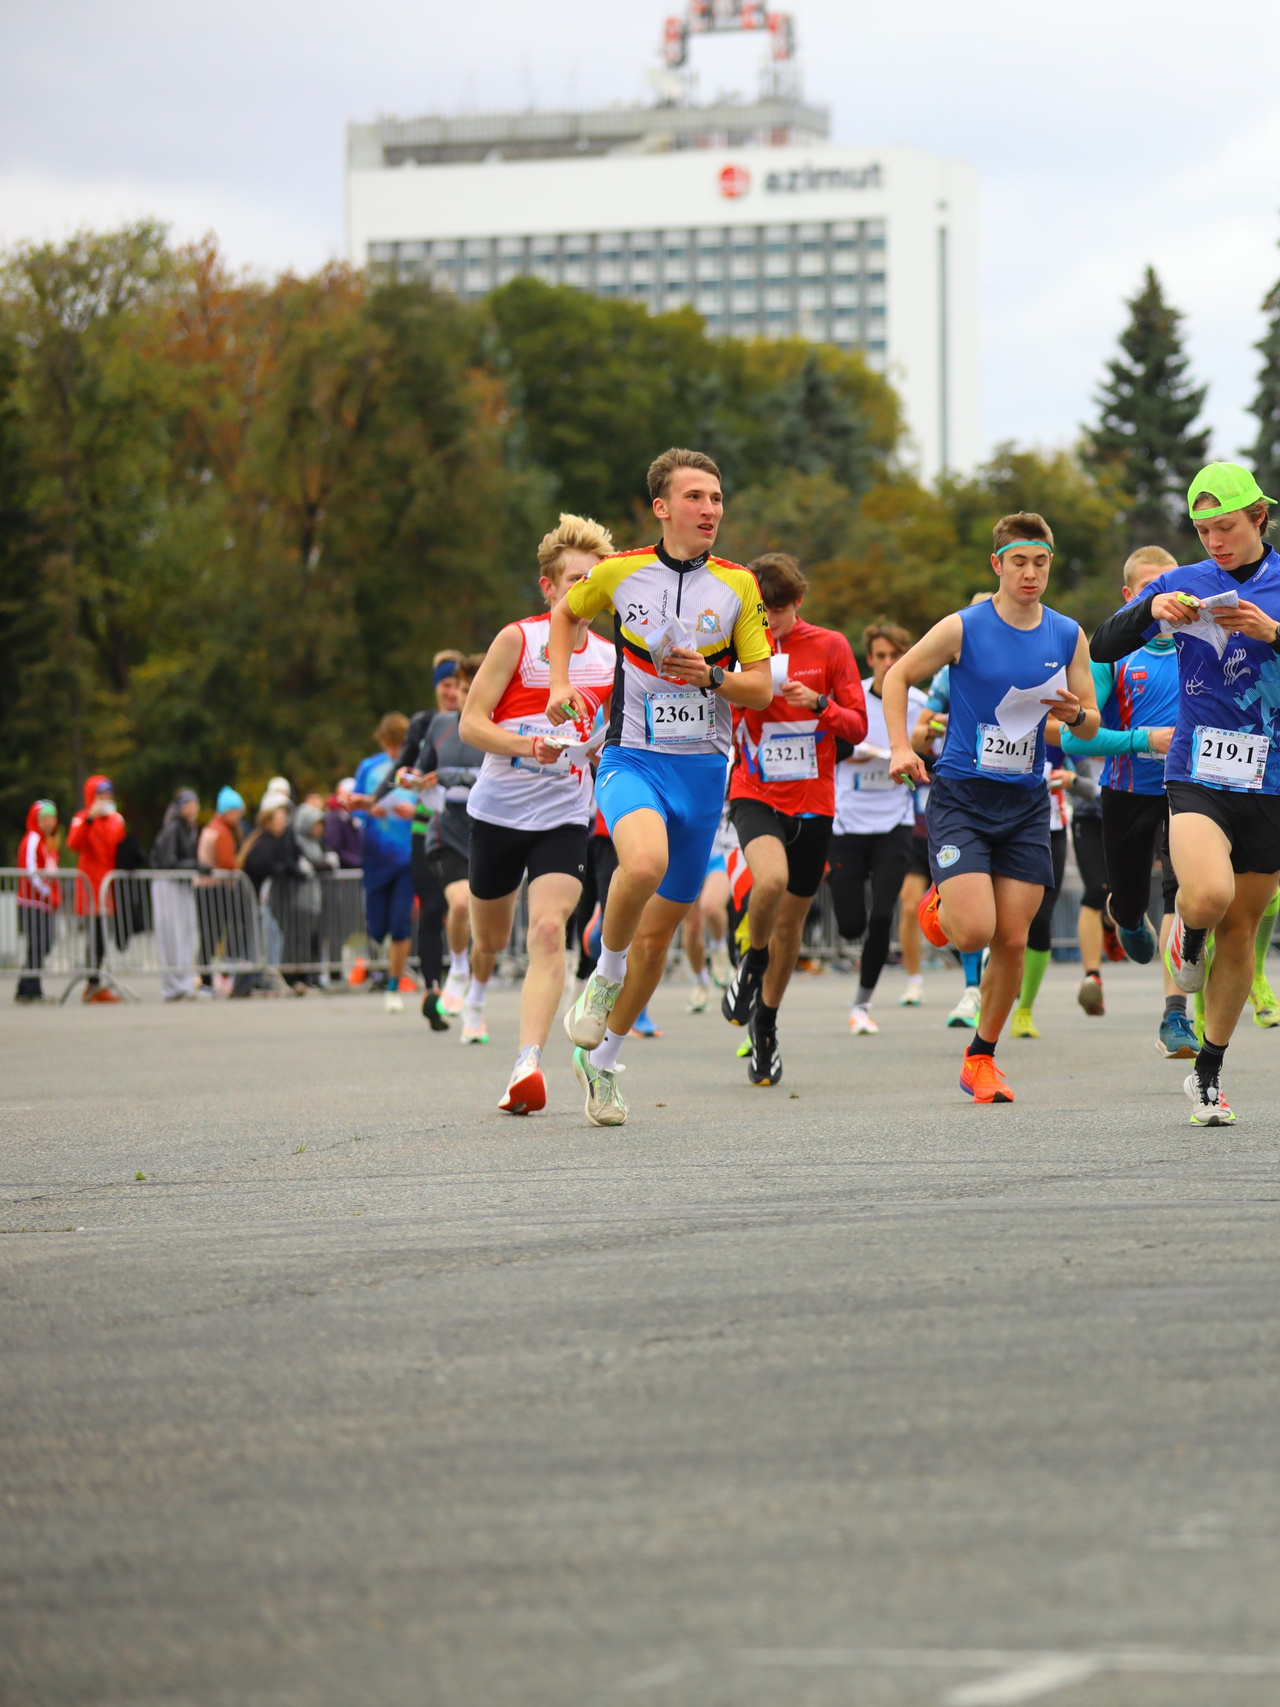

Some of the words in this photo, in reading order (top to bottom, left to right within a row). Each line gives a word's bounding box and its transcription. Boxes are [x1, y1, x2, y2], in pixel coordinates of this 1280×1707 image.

[764, 161, 883, 192] azimut
[660, 589, 669, 619] VICTORY
[654, 704, 706, 724] 236.1
[764, 745, 806, 763] 232.1
[984, 737, 1028, 756] 220.1
[1200, 739, 1255, 765] 219.1
